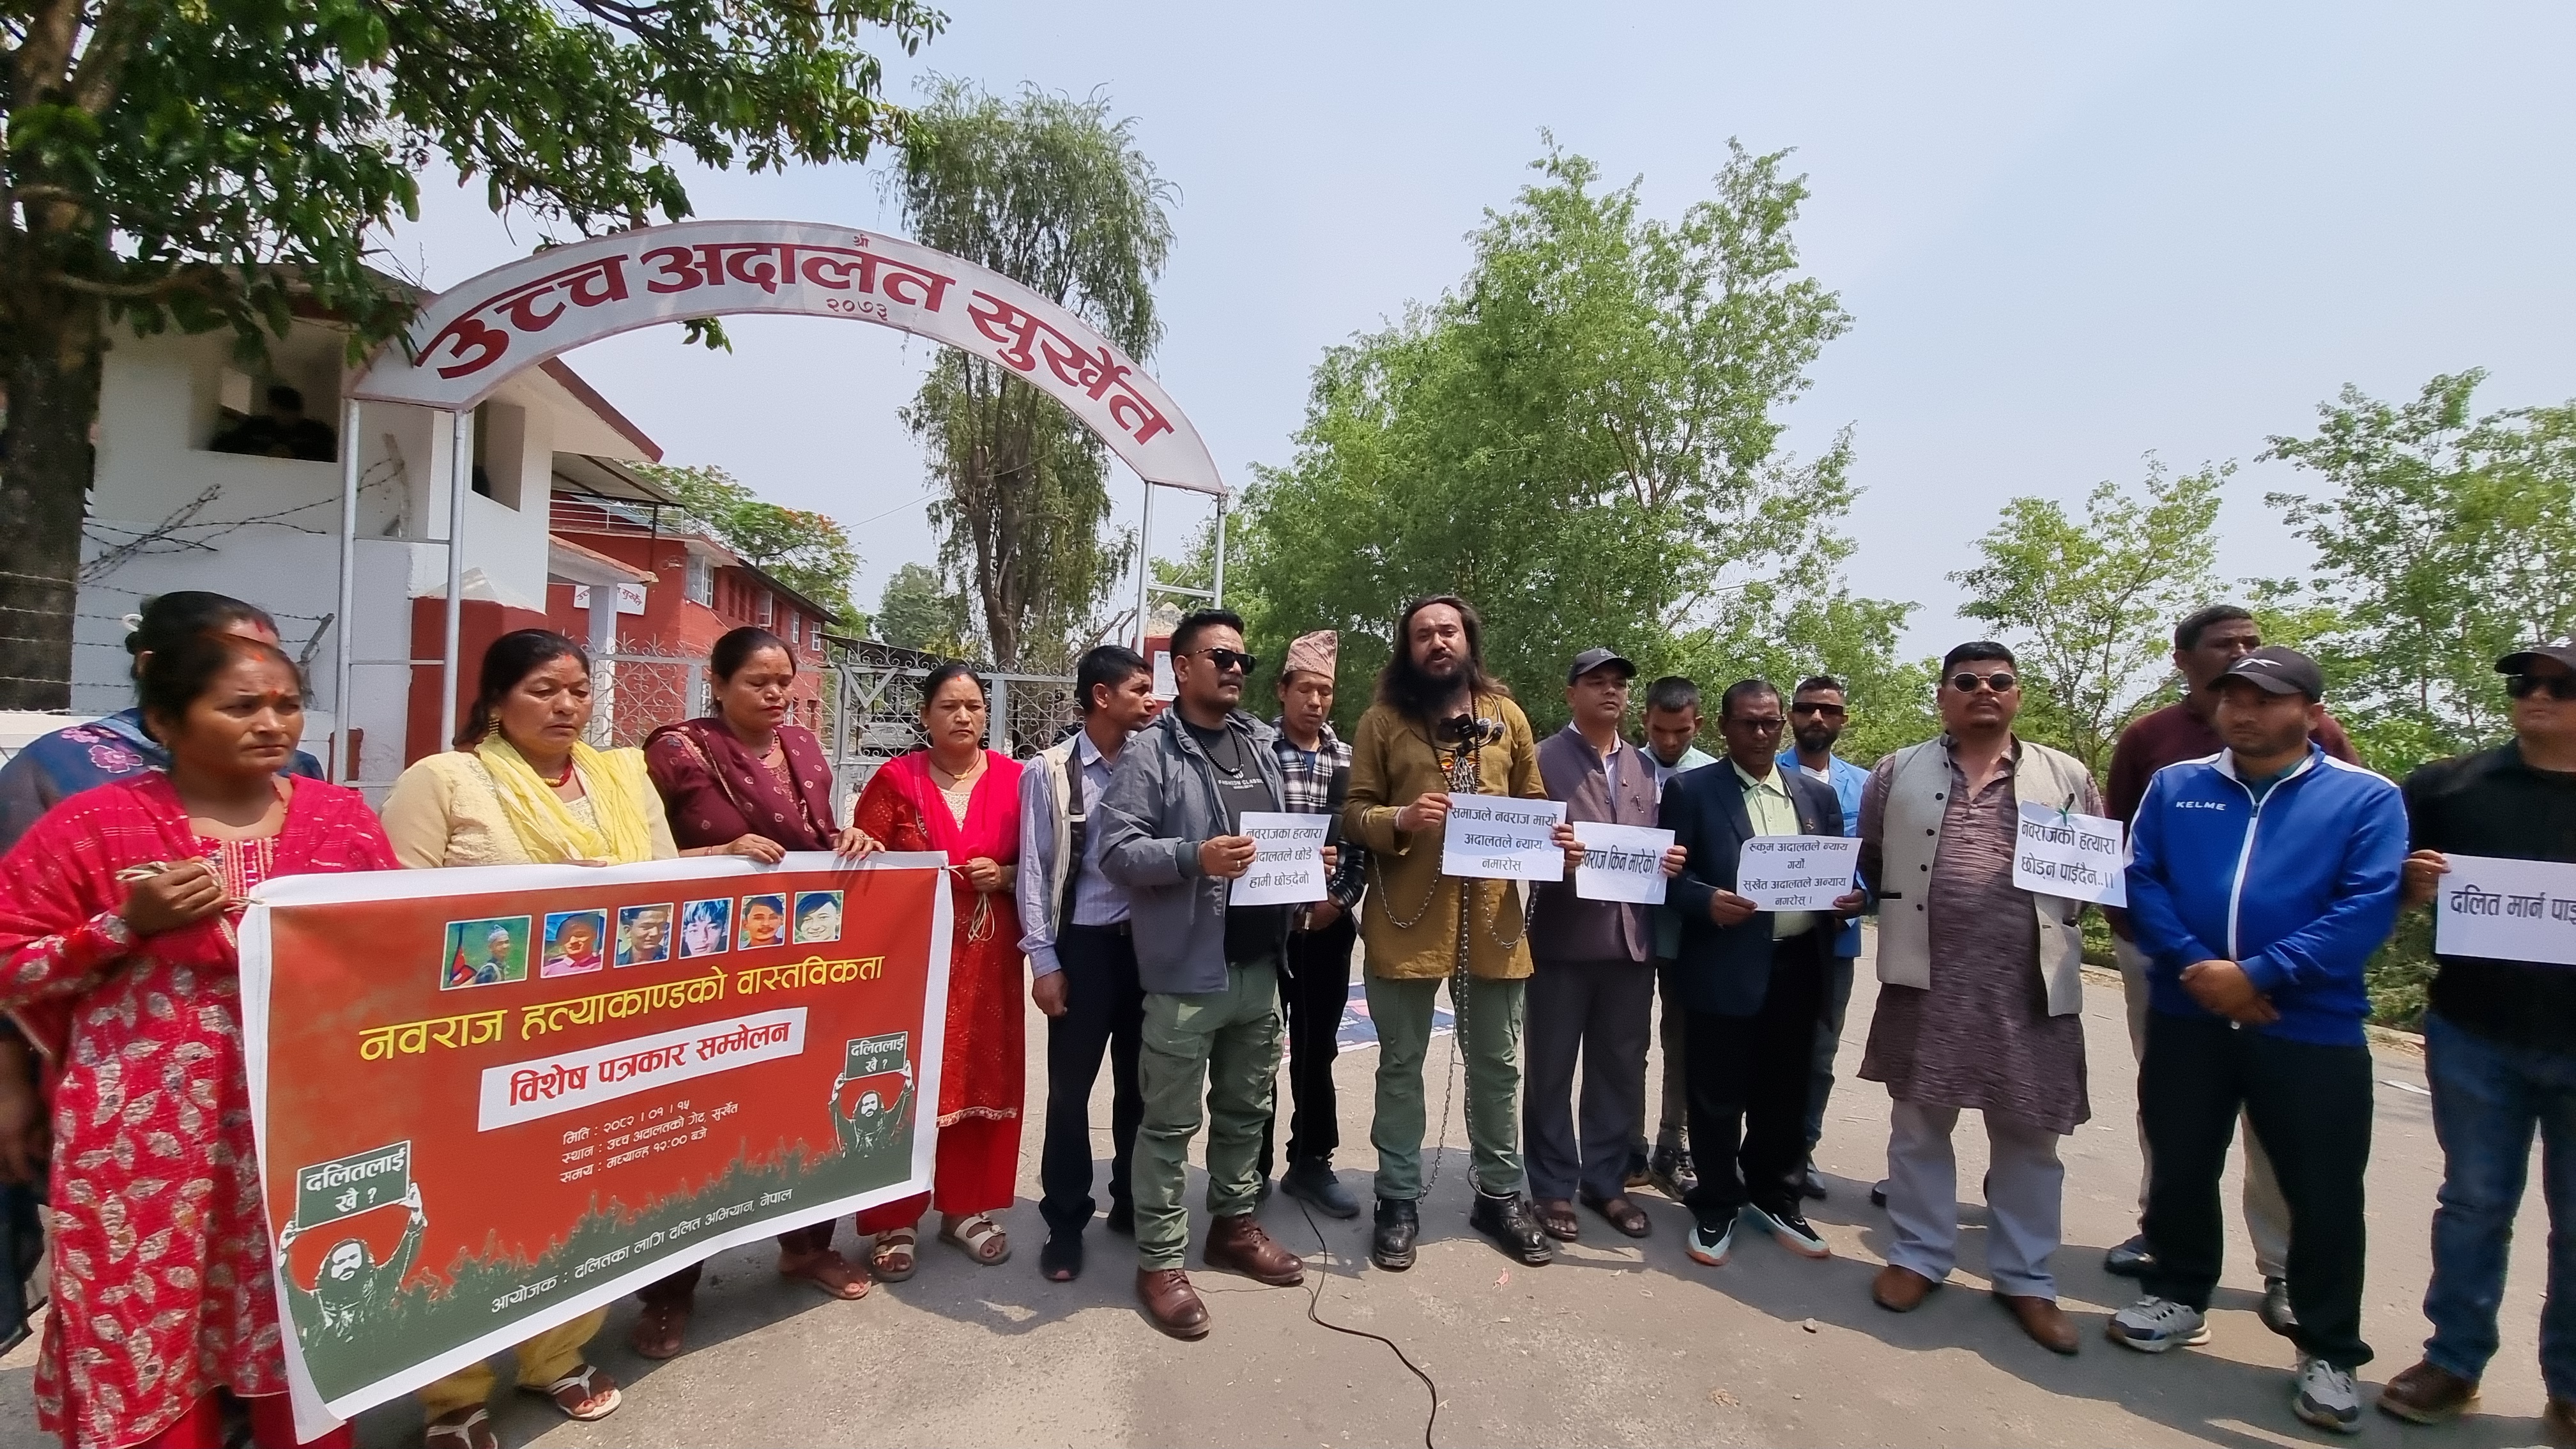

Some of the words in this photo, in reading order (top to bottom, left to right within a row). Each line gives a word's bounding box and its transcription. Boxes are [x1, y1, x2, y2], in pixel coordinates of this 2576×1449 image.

[853, 234, 870, 248] श्री
[826, 298, 887, 321] २०७३
[415, 254, 629, 379] उच्च
[640, 241, 956, 313] अदालत
[967, 288, 1174, 446] सुर्खेत
[1452, 807, 1491, 822] समाजले
[1495, 811, 1530, 825] नवराज
[2175, 801, 2227, 811] KELME
[1292, 828, 1324, 839] हत्यारा
[1464, 833, 1513, 848] अदालतले
[1516, 838, 1543, 850] न्याय
[2021, 820, 2076, 847] नवराजको
[2079, 832, 2116, 855] हत्यारा
[1294, 846, 1312, 861] छोडे
[1777, 840, 1820, 852] अदालतले
[1823, 843, 1849, 852] न्याय
[1482, 857, 1522, 873] नमारोस्
[1581, 848, 1608, 870] वराज
[1607, 844, 1628, 871] किन
[1628, 848, 1657, 875] मारेको
[1249, 872, 1271, 888] हामी
[1742, 878, 1768, 892] सुर्खेत
[1770, 876, 1812, 889] अदालतले
[1814, 877, 1847, 887] अन्याय
[1775, 894, 1806, 907] नगरोस्
[2450, 884, 2503, 916] दलित
[359, 1009, 510, 1063] नवराज
[521, 962, 728, 1041] हत्याकाण्डको
[737, 955, 885, 996] वास्तविकता
[850, 1035, 905, 1057] दलितलाई
[509, 1063, 586, 1108] विशेष
[597, 1045, 688, 1085] पत्रकार
[696, 1020, 793, 1061] सम्मेलन
[561, 1144, 594, 1164] स्थान
[606, 1134, 629, 1151] उच्च
[633, 1114, 685, 1142] अदालतको
[711, 1101, 739, 1121] सुर्खेत
[563, 1126, 591, 1146] मिति
[603, 1115, 634, 1134] २०८२
[559, 1163, 594, 1184] समय
[691, 1126, 708, 1140] बजे
[305, 1147, 406, 1192] दलितलाई
[367, 1187, 378, 1204] ?
[491, 1274, 558, 1313] आयोजक
[574, 1244, 630, 1278] दलितका
[634, 1229, 666, 1255] लागि
[669, 1216, 702, 1240] दलित
[760, 1188, 793, 1208] नेपाल
